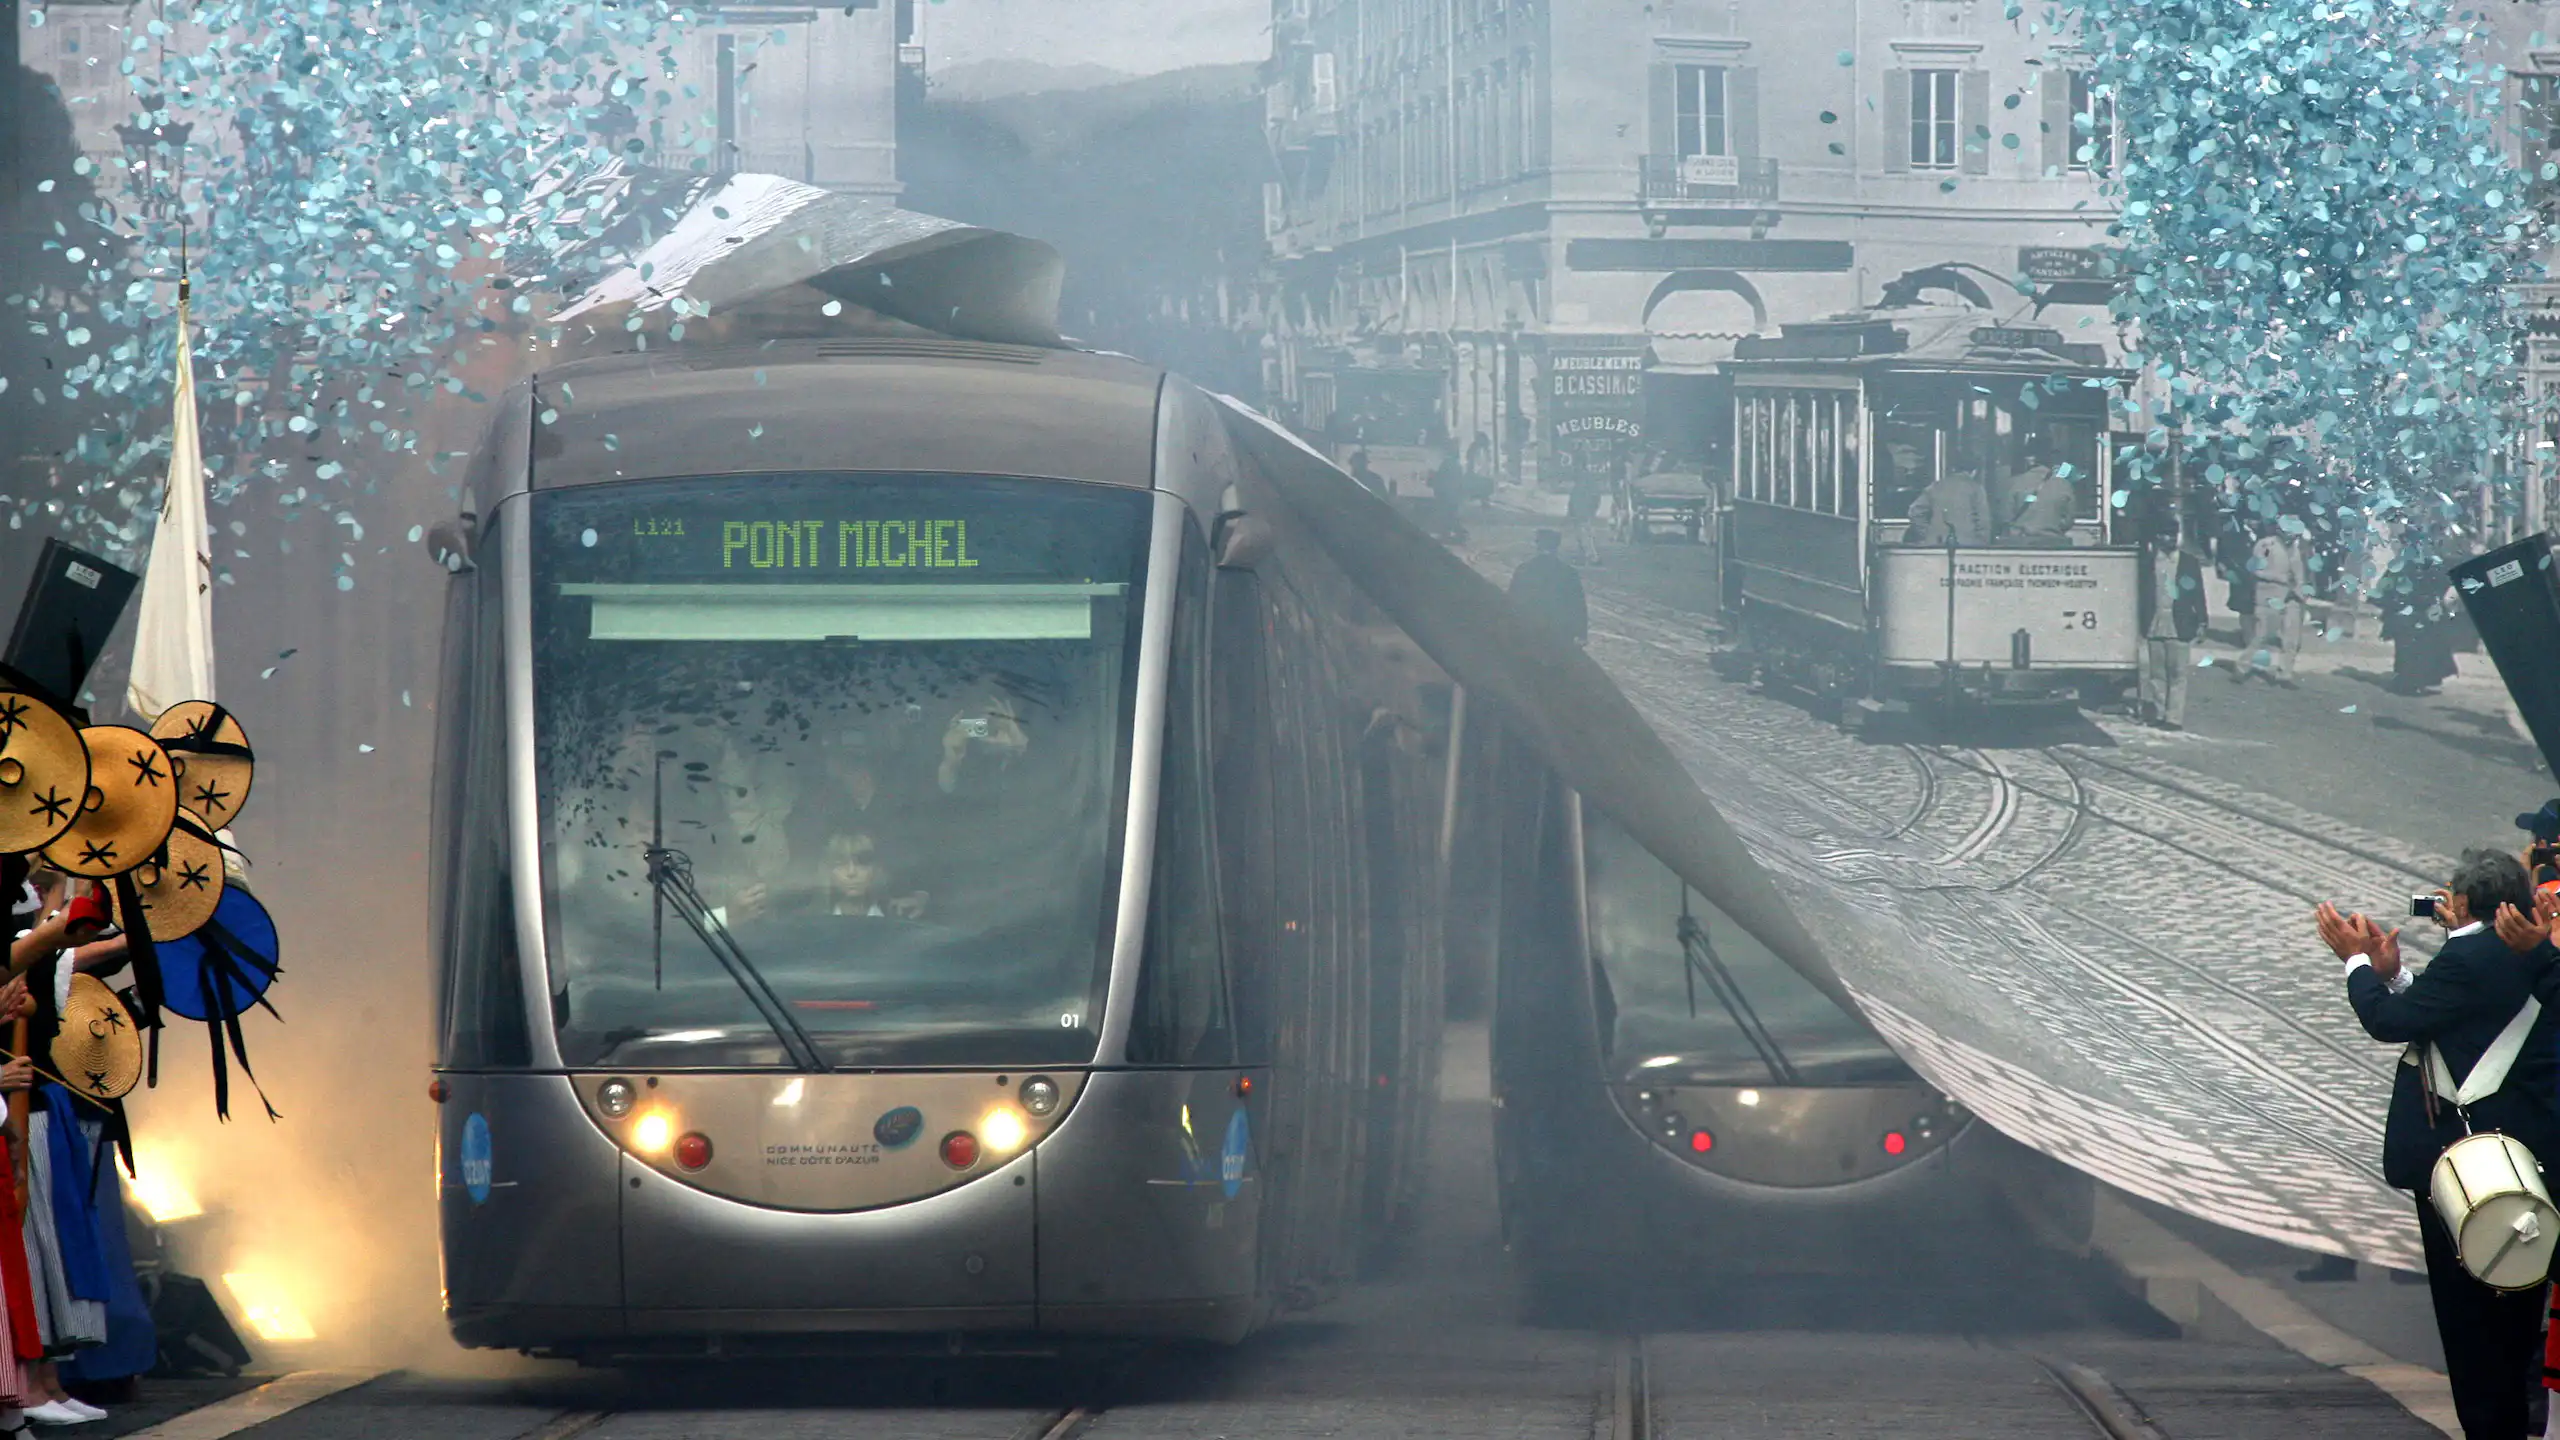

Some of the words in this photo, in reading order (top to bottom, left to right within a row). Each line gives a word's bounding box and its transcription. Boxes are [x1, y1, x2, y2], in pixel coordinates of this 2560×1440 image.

[1553, 356, 1642, 370] AMEUBLEMENTS
[1556, 416, 1640, 437] MEUBLES
[723, 520, 824, 568] PONT
[839, 520, 979, 568] MICHEL
[1060, 1013, 1079, 1028] 01
[766, 1156, 797, 1165] NICE
